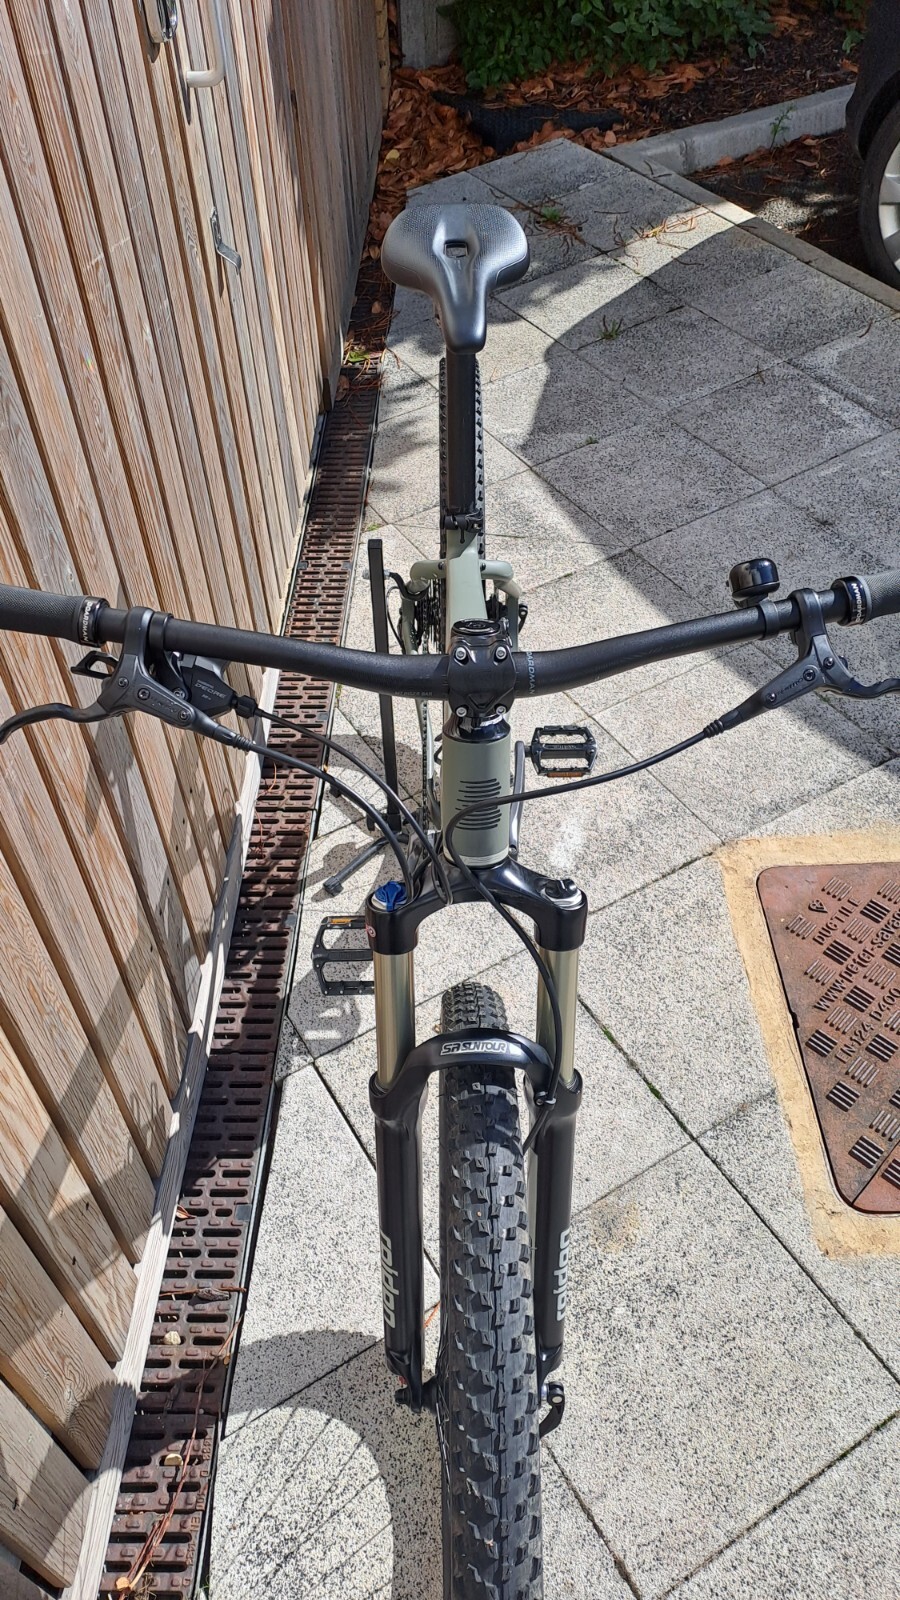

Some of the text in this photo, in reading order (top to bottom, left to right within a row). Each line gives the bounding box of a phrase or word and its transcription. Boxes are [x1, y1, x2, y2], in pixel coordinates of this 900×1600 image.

[82, 601, 93, 641] BOARDMAN
[812, 896, 861, 946] DUCTILE
[869, 987, 900, 1022] D400
[461, 1041, 507, 1053] SUNTOUR
[380, 1229, 399, 1329] raidon
[553, 1228, 570, 1322] raidon
